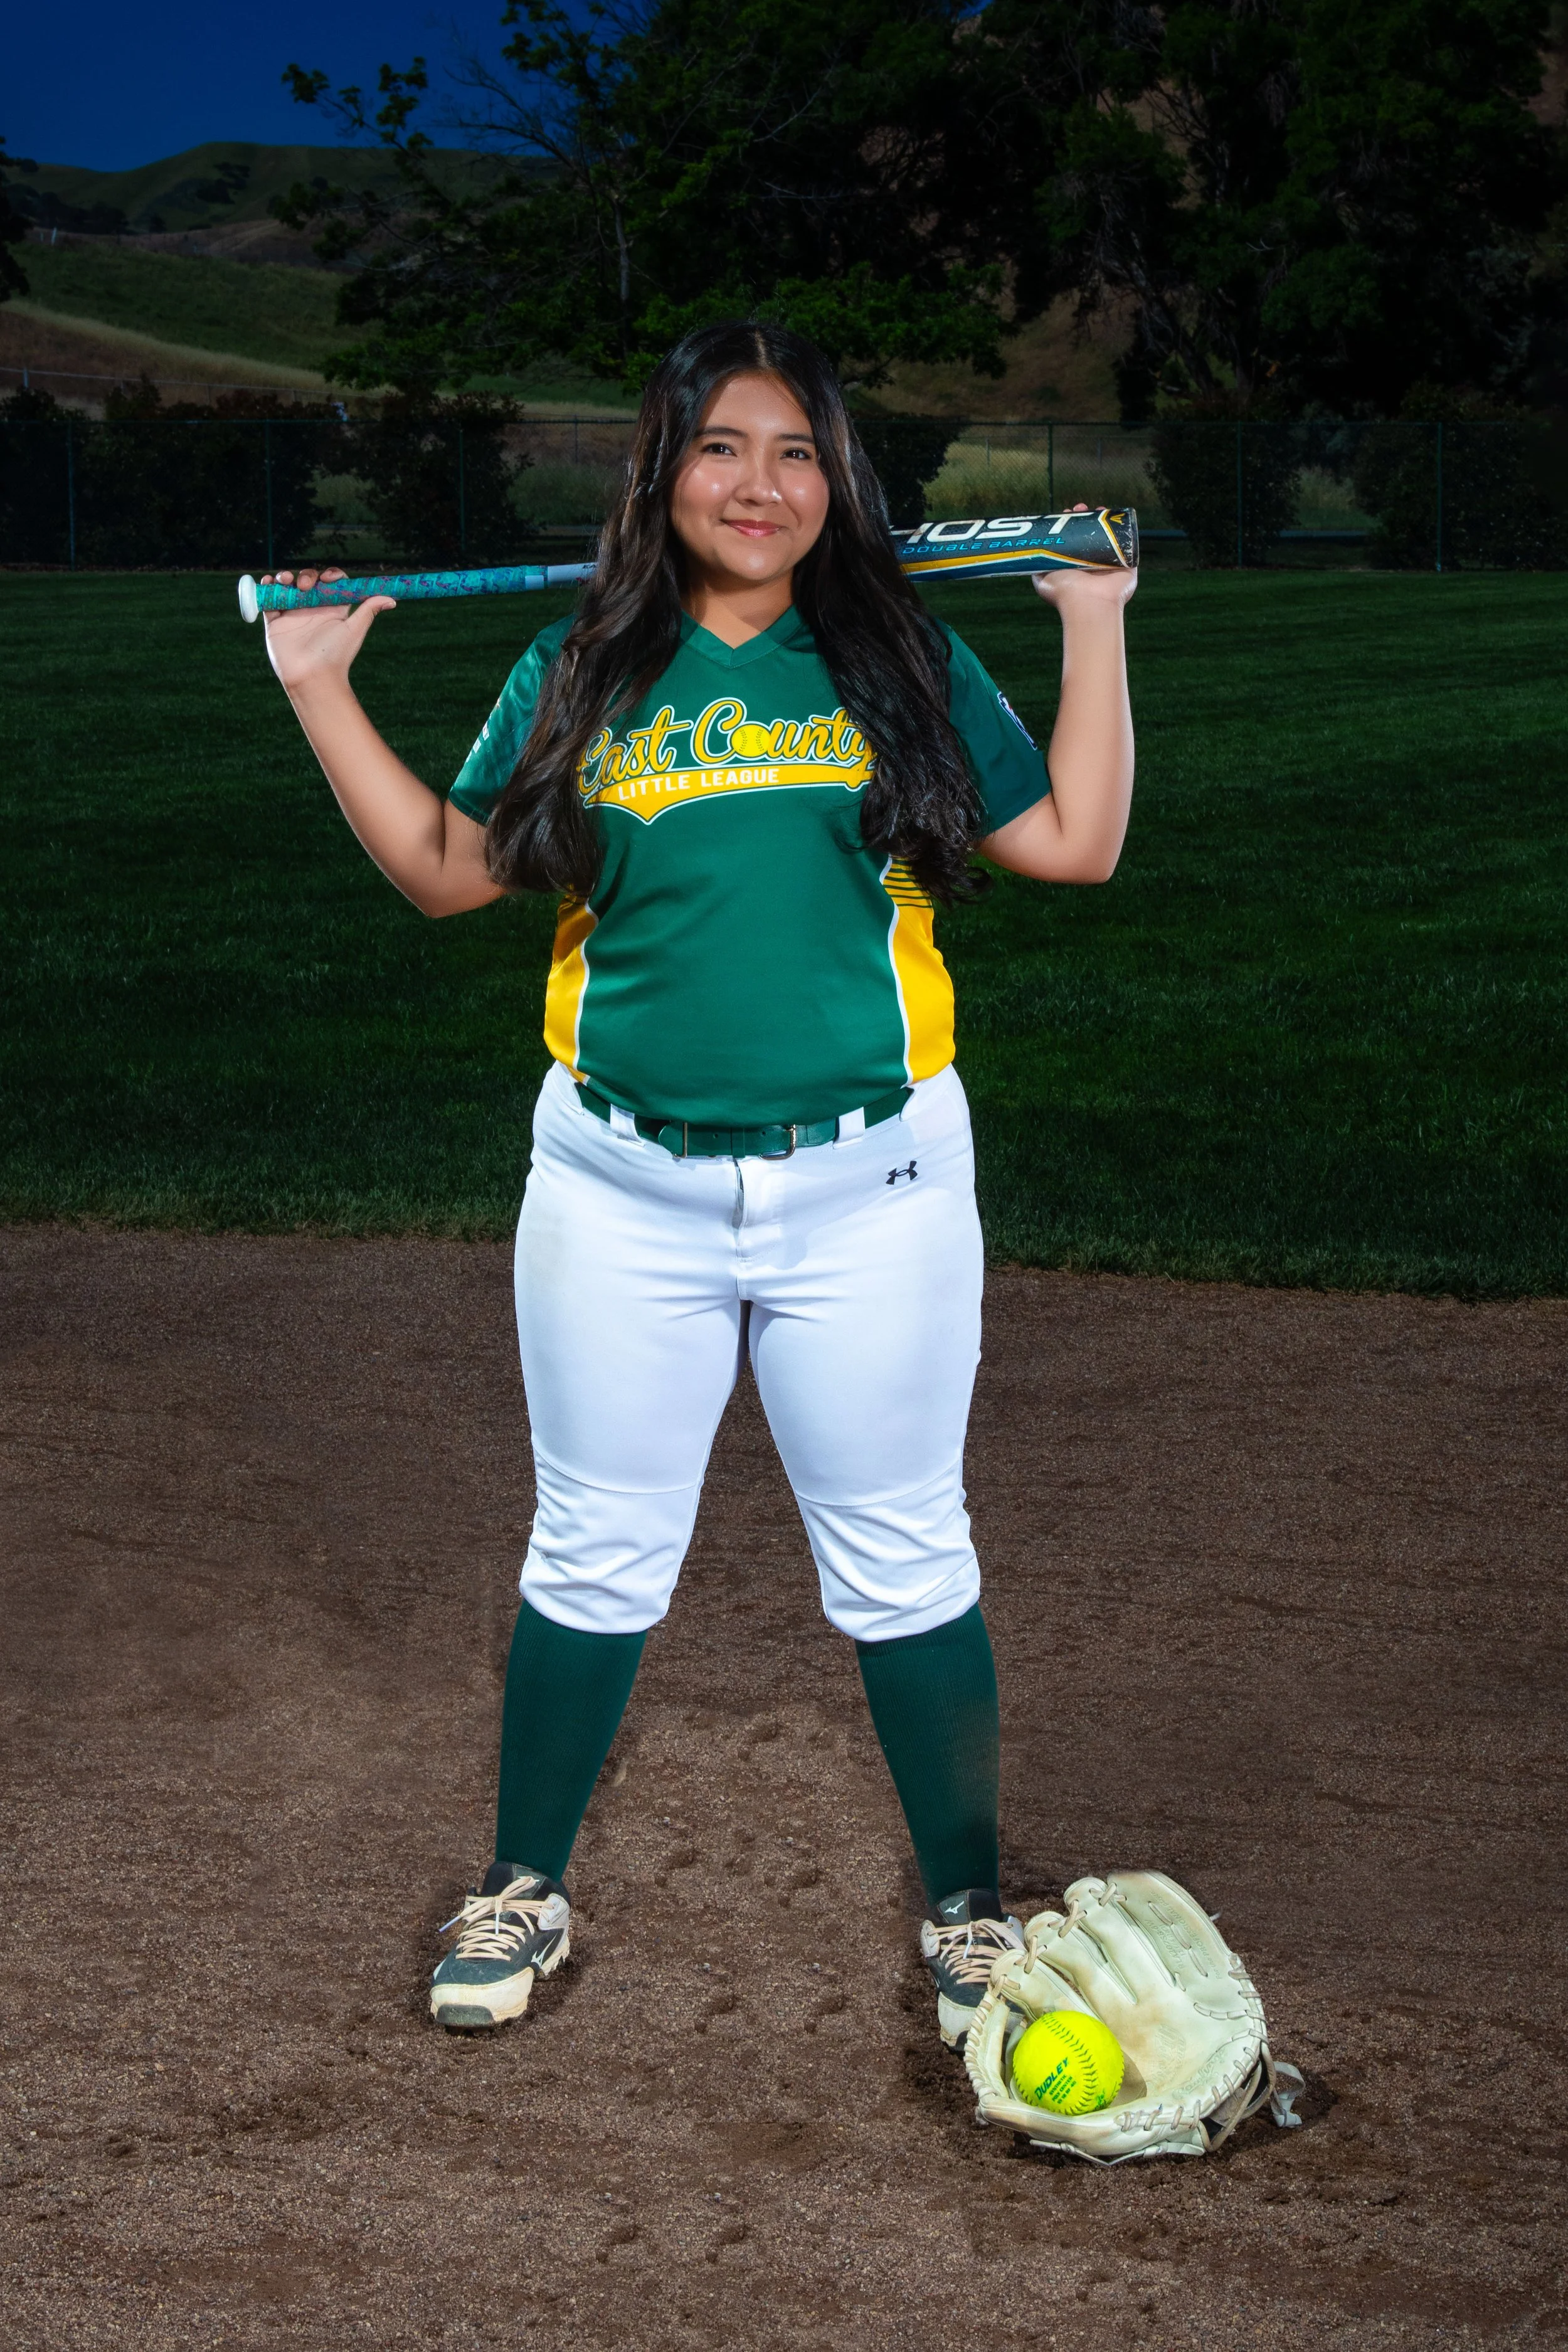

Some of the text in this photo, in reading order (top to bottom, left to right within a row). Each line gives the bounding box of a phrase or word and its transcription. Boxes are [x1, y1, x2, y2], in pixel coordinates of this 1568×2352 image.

[888, 512, 1096, 544] HOST
[903, 537, 1066, 554] DOUBLE BARREL
[577, 707, 692, 797] East
[618, 768, 780, 801] LITTLE LEAGUE
[1034, 2057, 1067, 2100] DUDLEY
[1049, 2074, 1066, 2095] SYNTHETIC
